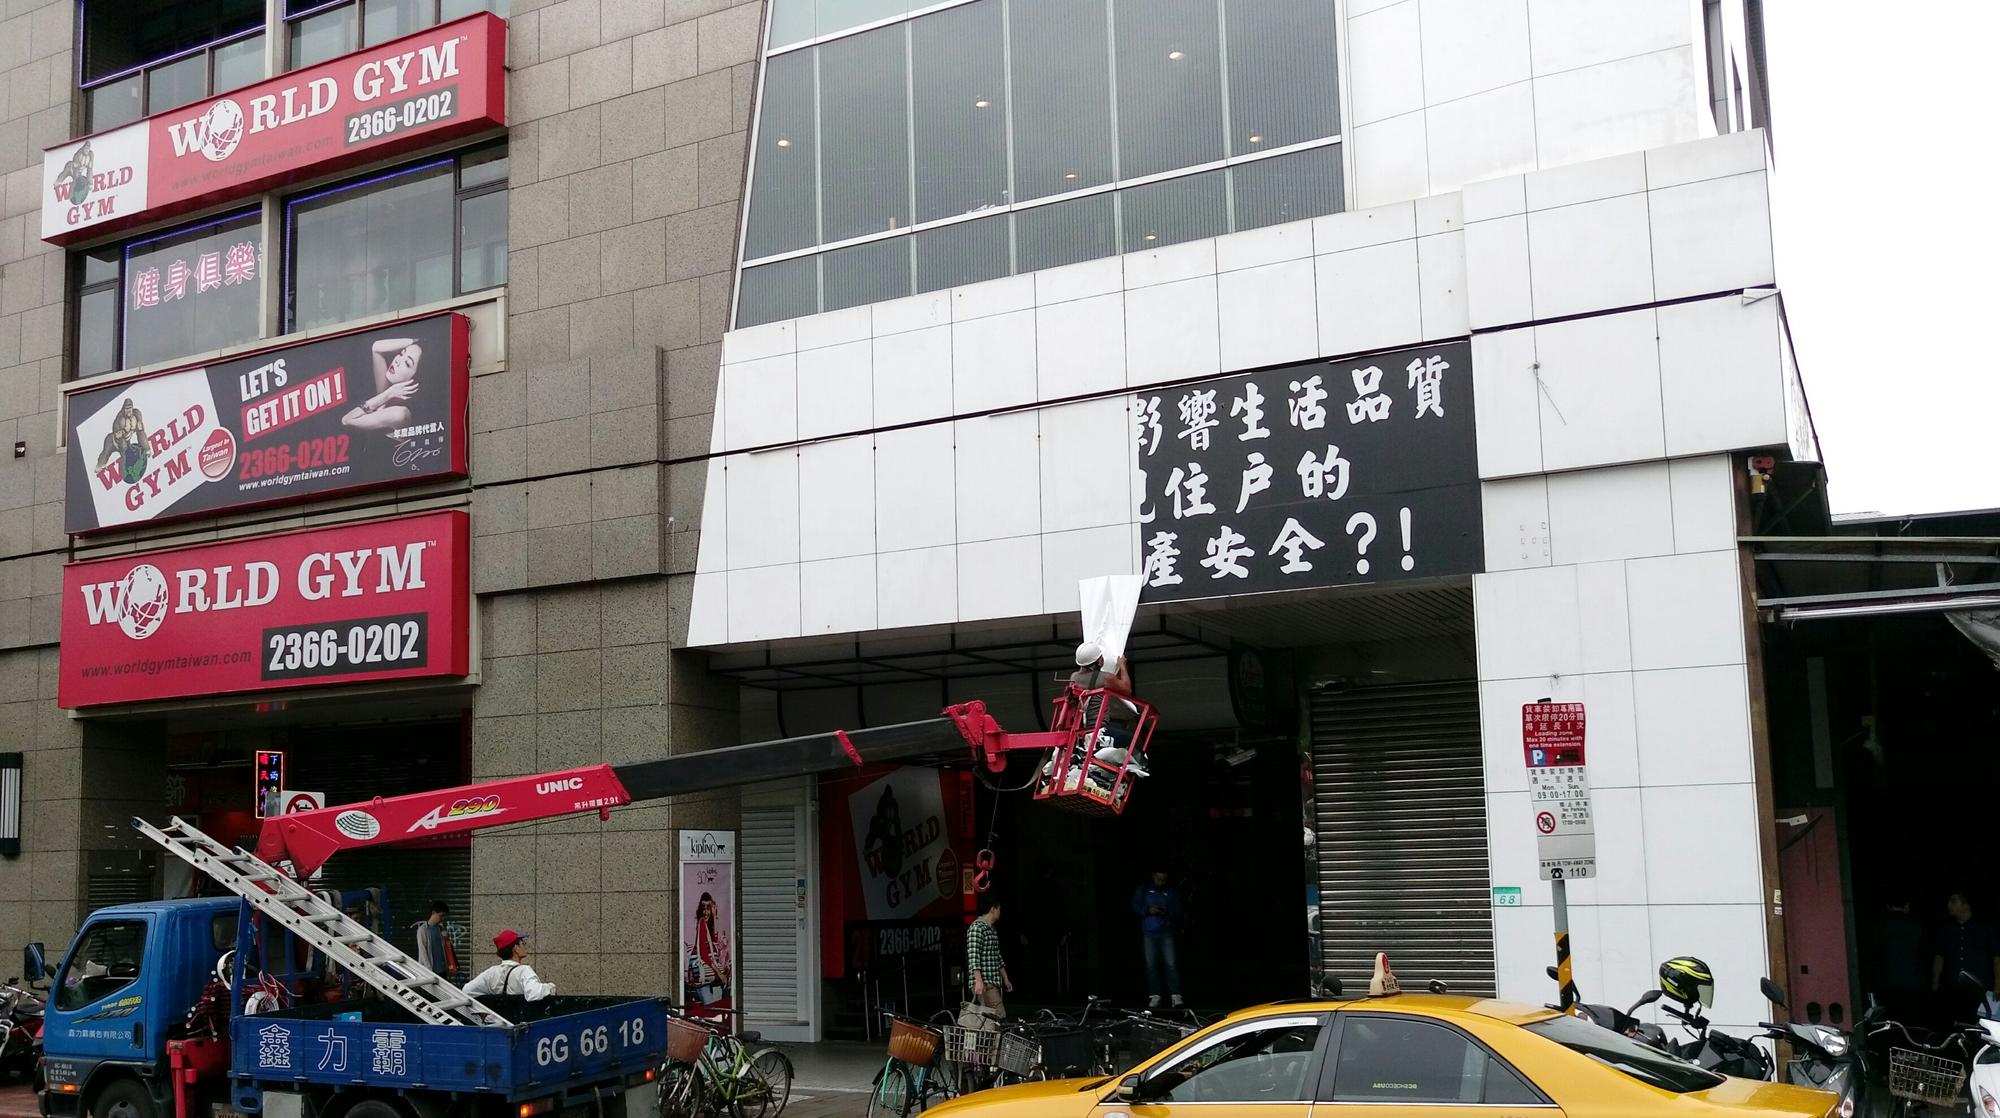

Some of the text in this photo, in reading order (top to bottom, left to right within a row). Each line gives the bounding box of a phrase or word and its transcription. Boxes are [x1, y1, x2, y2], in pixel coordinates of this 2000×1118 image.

[353, 38, 459, 101] GYM
[348, 91, 452, 144] 2366-0202
[66, 195, 116, 226] GYM
[131, 240, 261, 311] 健身俱樂
[240, 358, 288, 402] LET'S
[246, 397, 279, 436] GET
[283, 389, 300, 421] IT
[1137, 354, 1450, 456] 影響生活品質
[202, 448, 229, 463] Taiwan
[239, 434, 350, 481] 2366-0202
[239, 463, 350, 491] www.worldgymtaiwan.com
[125, 447, 192, 512] GYM
[298, 541, 427, 600] GYM
[81, 648, 252, 680] www.worldgymtaiwan.com
[268, 620, 420, 672] 2366-0202
[448, 795, 500, 818] 290
[536, 777, 583, 795] UNIC
[690, 838, 716, 858] kipling
[886, 857, 931, 909] GYM
[1569, 867, 1587, 877] 110
[1499, 895, 1516, 904] 68
[879, 926, 941, 955] 2366-0202
[258, 1023, 408, 1076] 鑫力霸
[536, 1017, 645, 1066] 6G 66 18
